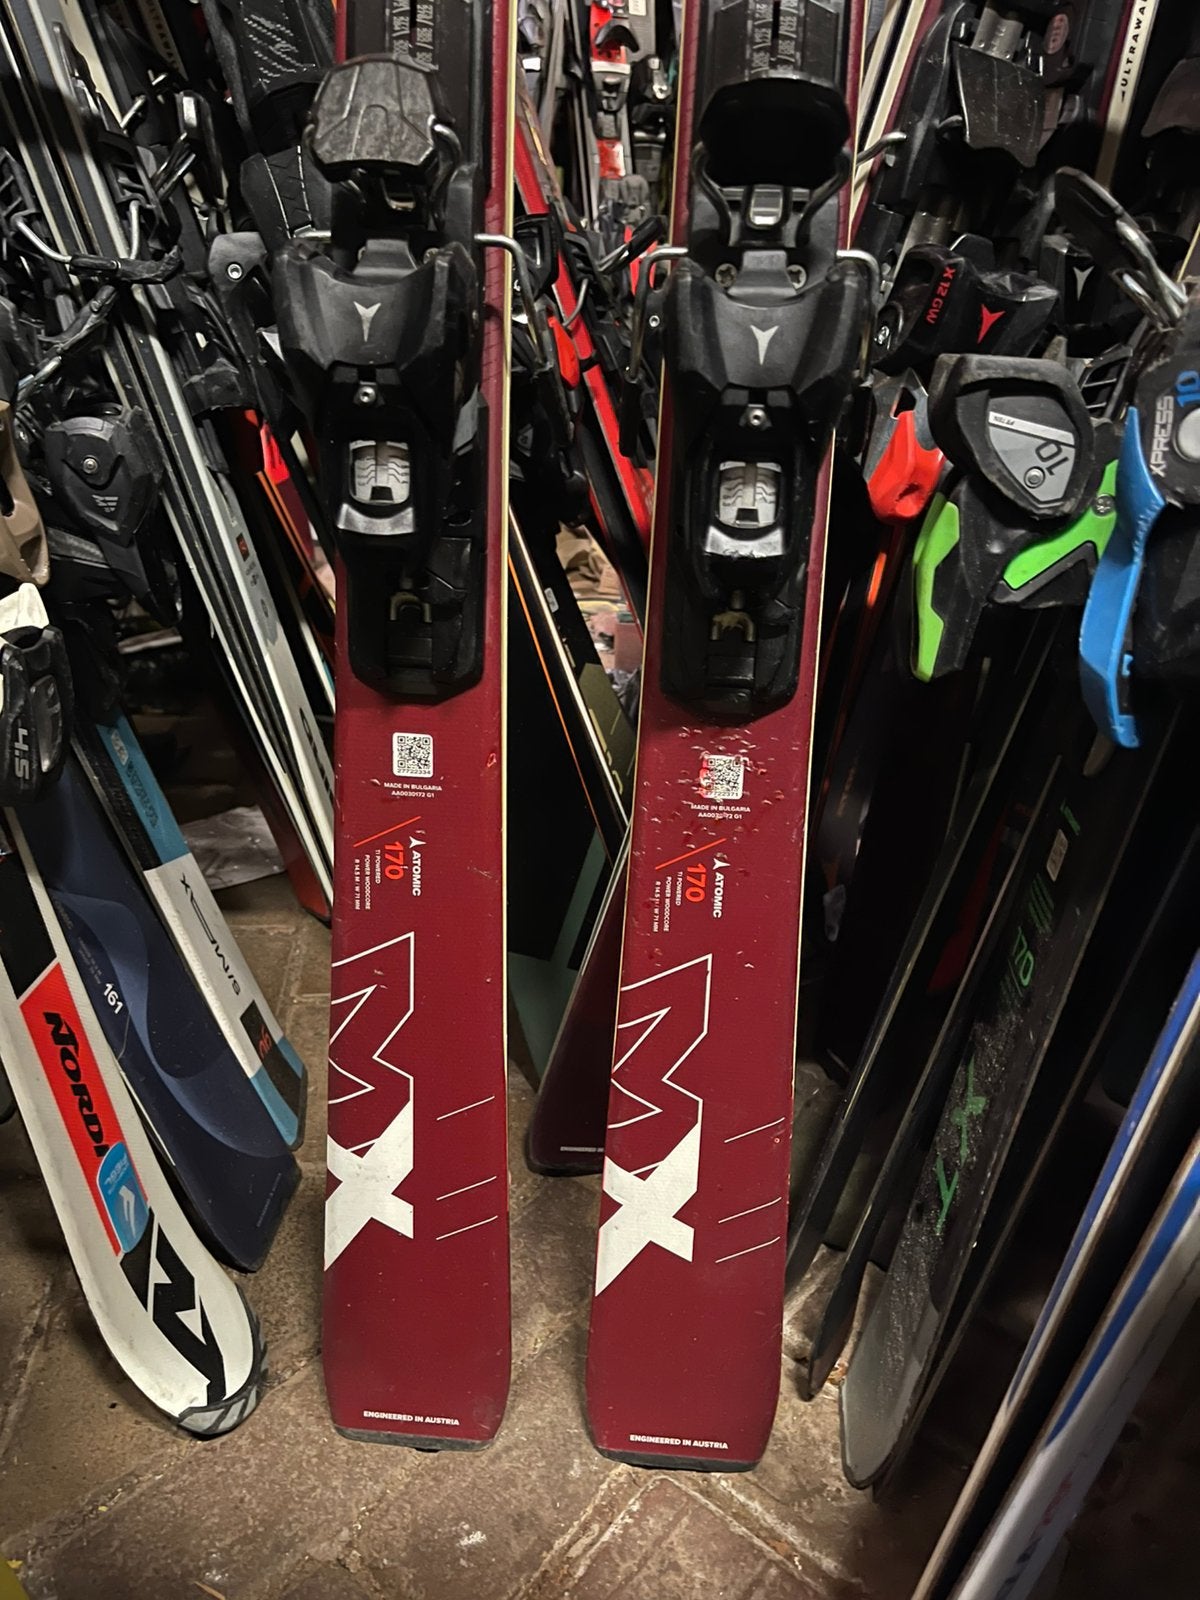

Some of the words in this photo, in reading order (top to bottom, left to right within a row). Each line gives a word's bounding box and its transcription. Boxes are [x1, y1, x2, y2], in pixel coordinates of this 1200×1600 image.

[1149, 396, 1174, 478] XPRESS
[1035, 440, 1070, 476] 10
[14, 728, 29, 780] 4.5
[384, 841, 404, 880] 170
[412, 850, 421, 897] ATOMIC
[675, 877, 683, 906] POWERED
[685, 863, 706, 902] 170
[713, 872, 724, 918] ATOMIC
[663, 898, 671, 932] WOODCORE
[102, 982, 126, 1015] 161
[43, 1011, 110, 1158] NORDI
[363, 1410, 414, 1422] ENGINEERED
[425, 1416, 460, 1426] AUSTRIA
[629, 1434, 681, 1445] ENGINEERED
[692, 1440, 729, 1450] AUSTRIA
